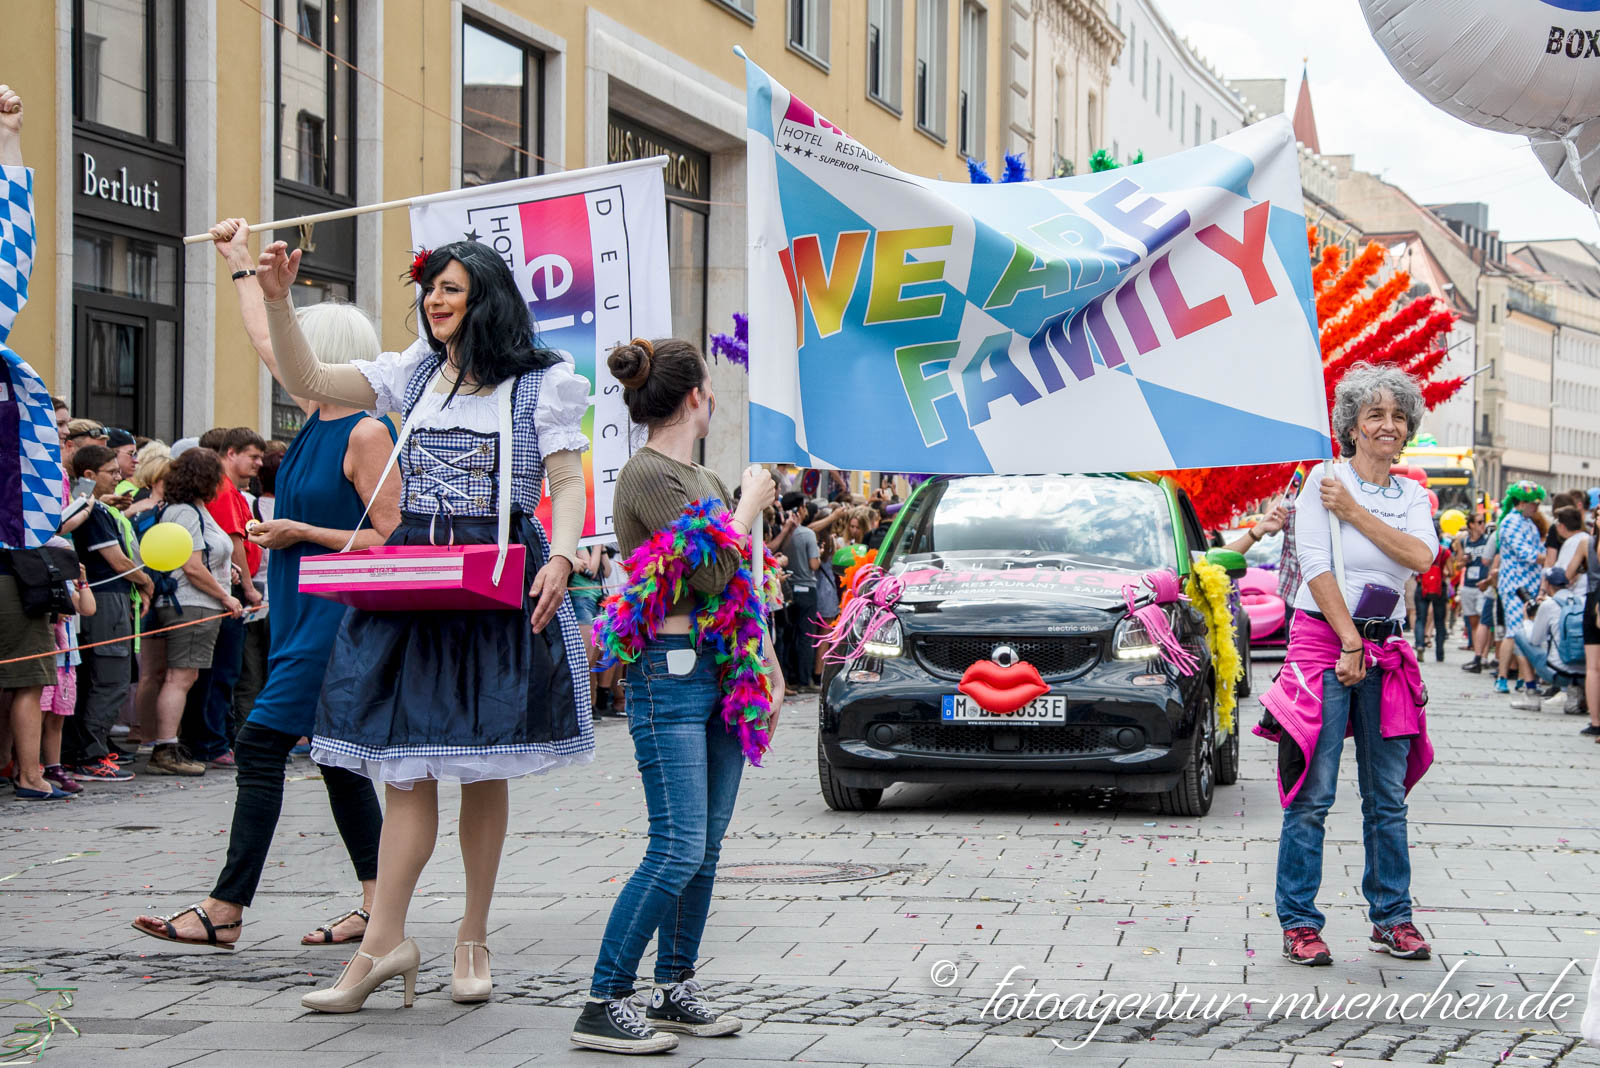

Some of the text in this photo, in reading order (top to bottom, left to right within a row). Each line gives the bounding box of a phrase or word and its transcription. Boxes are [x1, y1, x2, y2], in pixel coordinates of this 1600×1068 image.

[1545, 26, 1600, 58] BOX
[783, 126, 823, 147] HOTEL
[83, 152, 160, 212] Berluti
[818, 154, 860, 172] SUPERIOR
[490, 216, 514, 269] HOT
[982, 176, 1192, 312] ARE
[777, 224, 955, 350] WE
[894, 199, 1279, 448] FAMILY
[595, 198, 620, 525] DEUSCHE
[906, 583, 945, 592] OTEL
[960, 580, 1058, 590] RESTAURANT
[1047, 624, 1099, 633] electric drive
[955, 698, 967, 718] M
